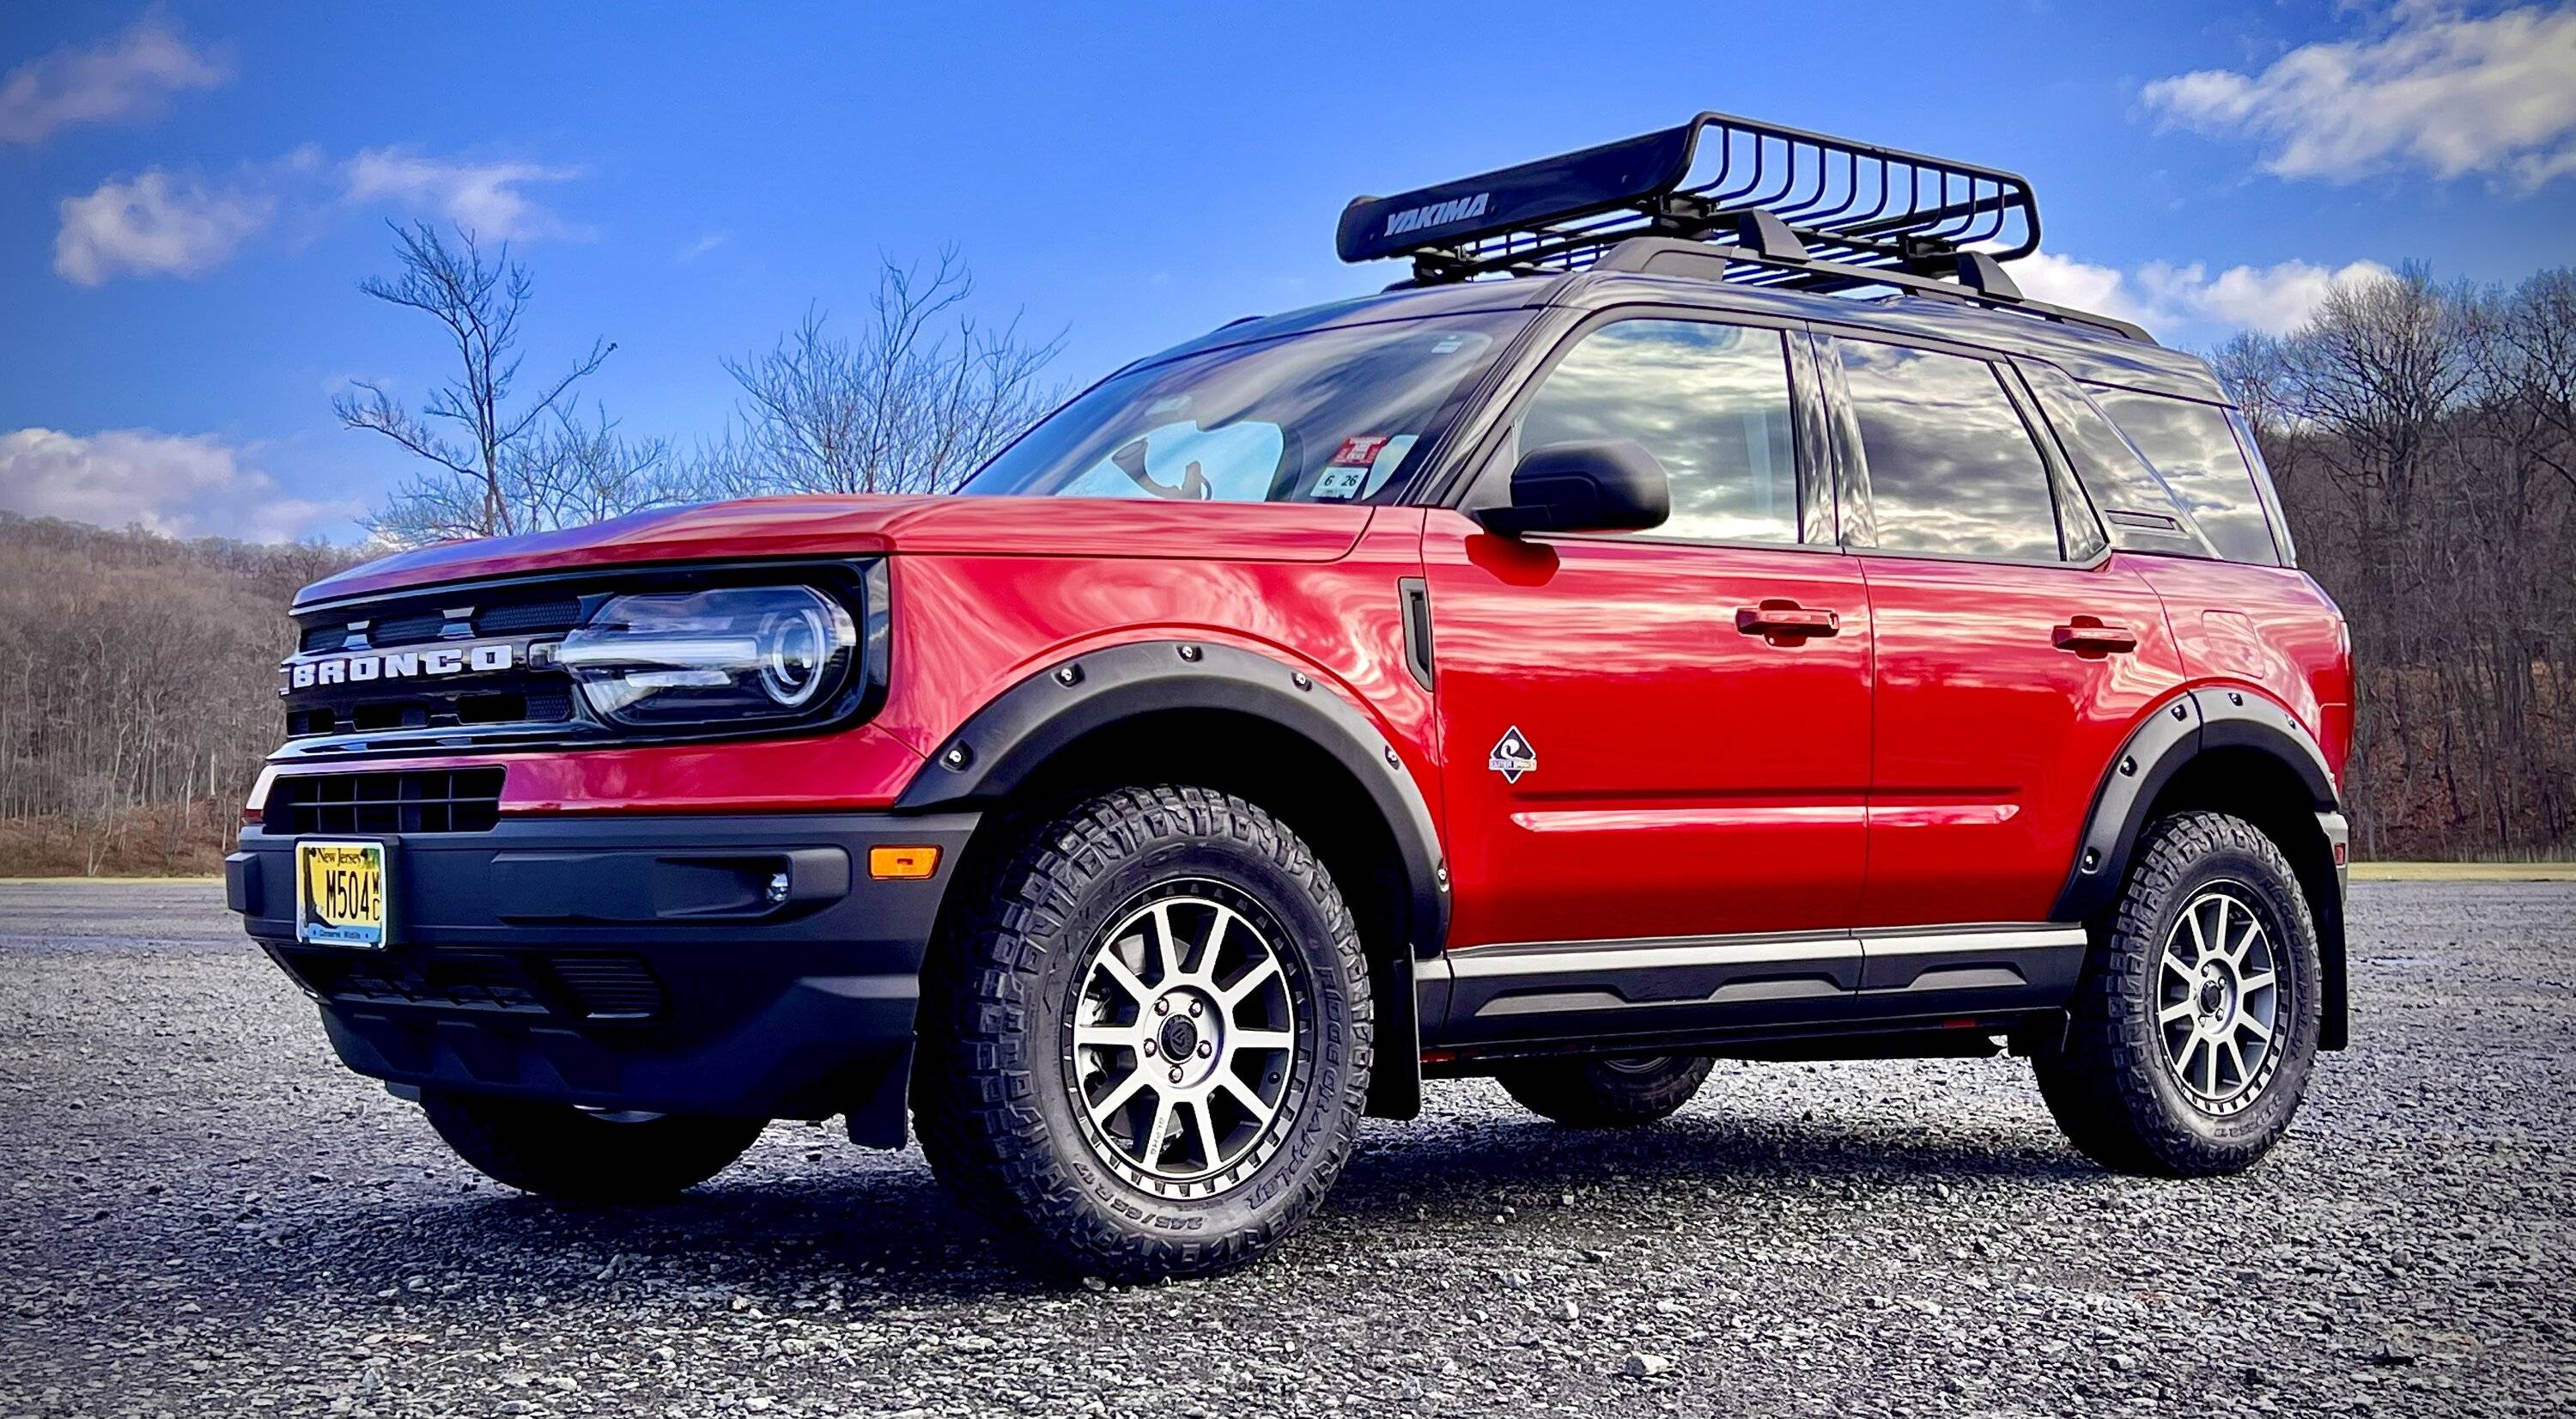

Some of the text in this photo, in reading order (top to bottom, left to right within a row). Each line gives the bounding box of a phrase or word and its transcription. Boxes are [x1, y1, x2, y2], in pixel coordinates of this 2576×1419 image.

[1384, 192, 1490, 237] YAKIMA
[1324, 474, 1359, 487] 6 26
[293, 645, 513, 688] BRONCO
[326, 869, 369, 921] M504
[1245, 965, 1343, 1210] RIDGE GRAPPLER
